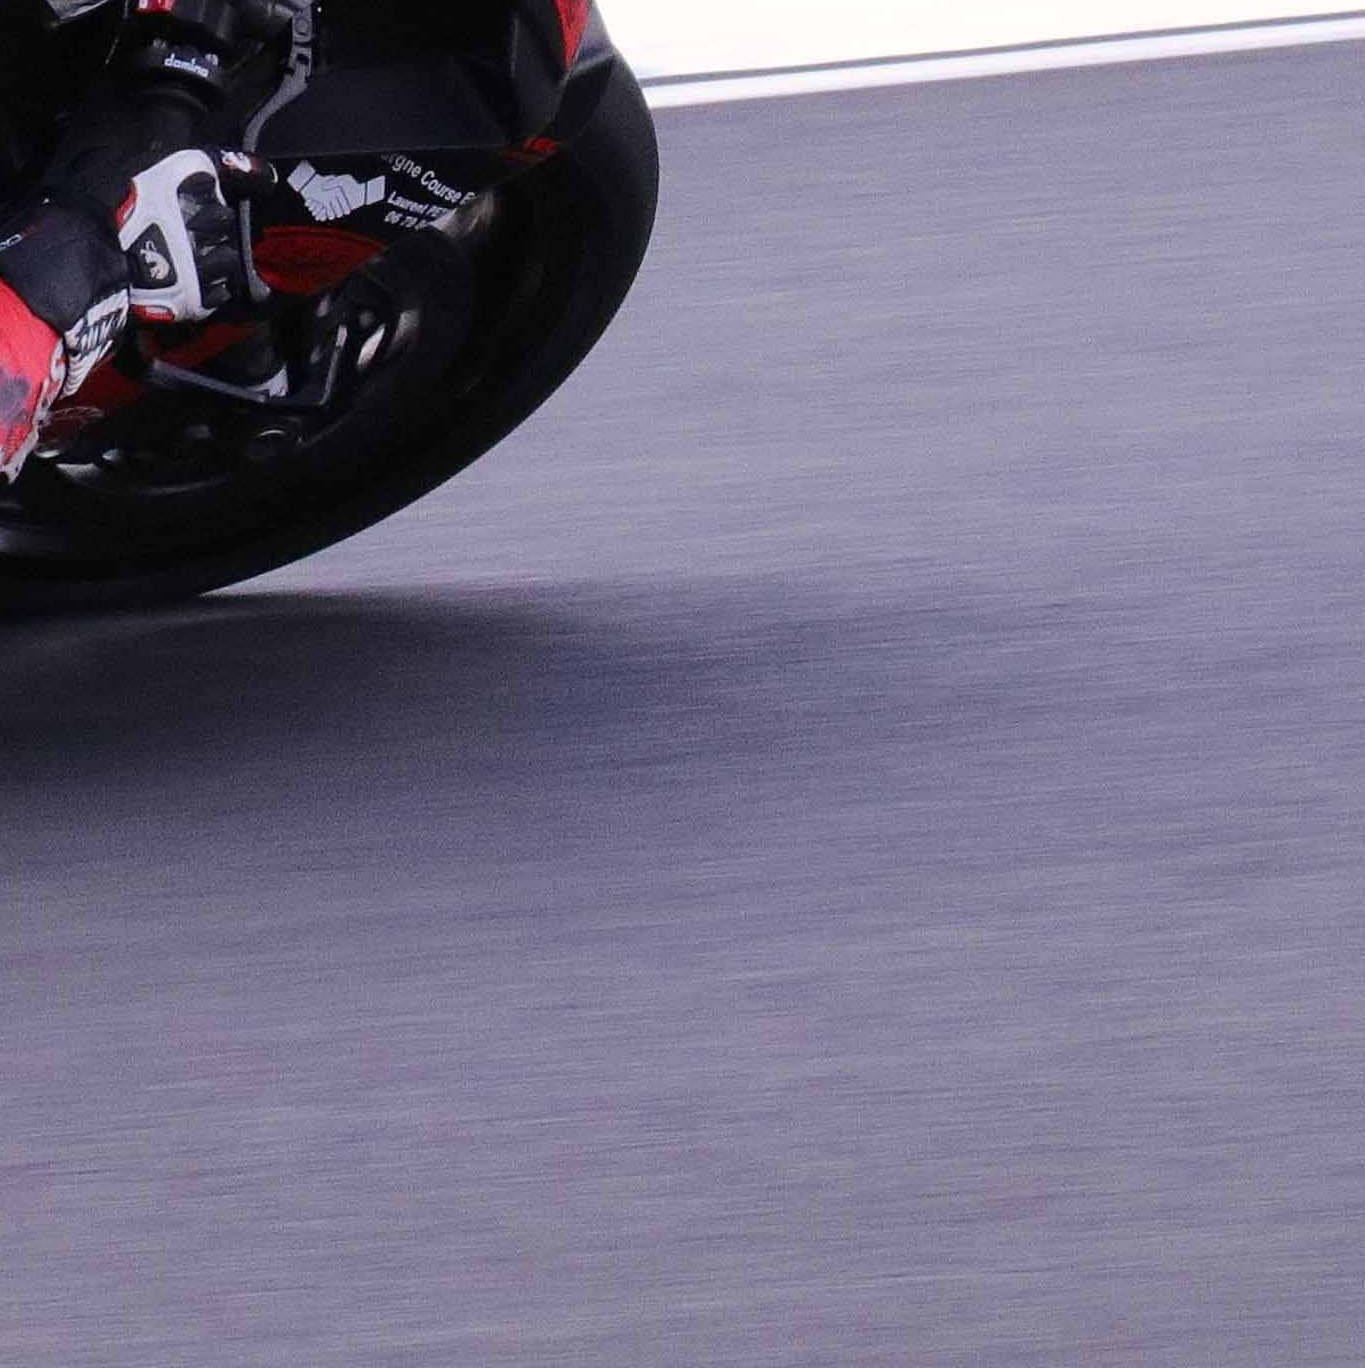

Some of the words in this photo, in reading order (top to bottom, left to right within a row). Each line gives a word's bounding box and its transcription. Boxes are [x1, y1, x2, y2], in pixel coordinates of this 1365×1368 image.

[164, 53, 209, 78] domino
[420, 170, 462, 203] Course
[387, 190, 429, 215] Laurent
